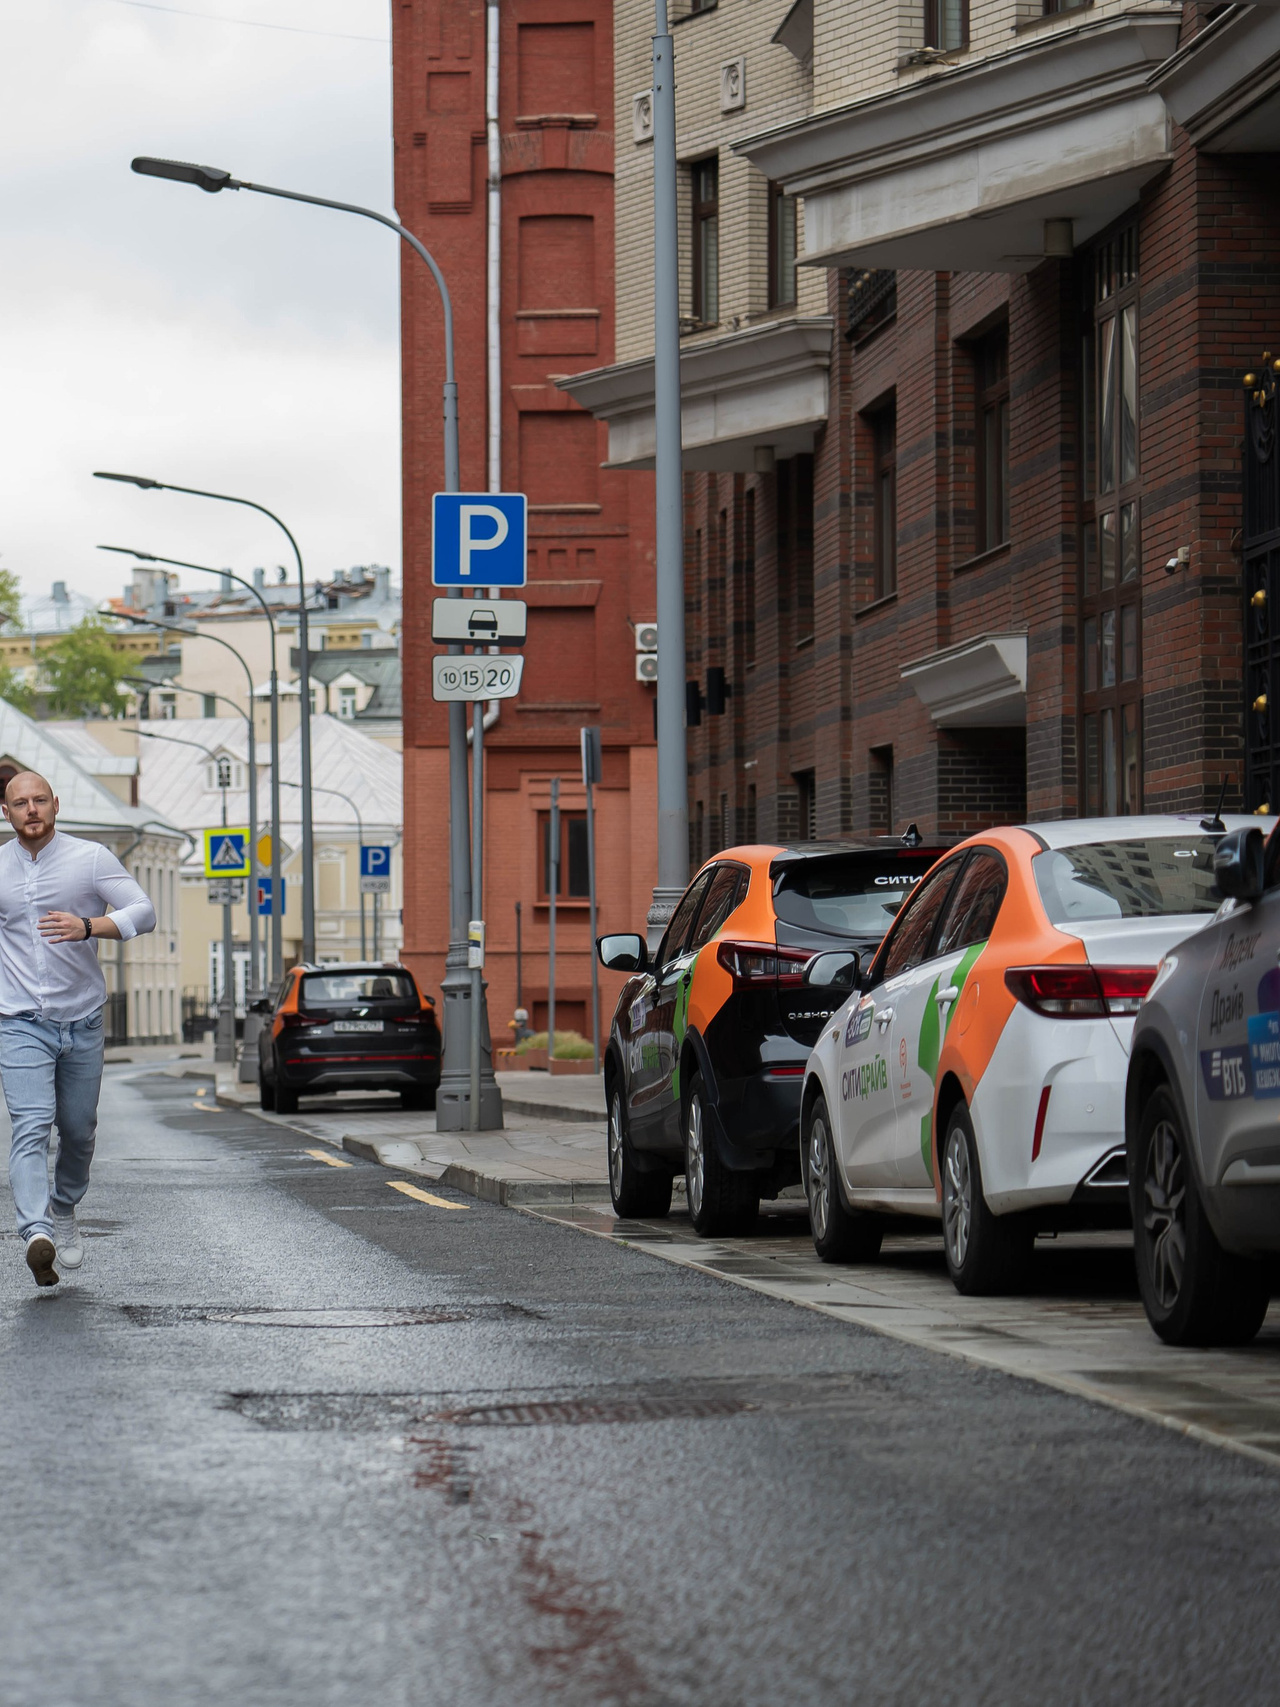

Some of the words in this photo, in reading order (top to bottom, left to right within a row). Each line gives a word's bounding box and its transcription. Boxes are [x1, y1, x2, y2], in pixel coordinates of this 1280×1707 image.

[459, 504, 509, 575] P
[443, 672, 457, 684] 10
[462, 670, 479, 686] 15
[486, 669, 511, 687] 20
[368, 848, 386, 873] P
[1219, 931, 1262, 971] Яндекс
[1210, 983, 1244, 1036] Драйв
[842, 1054, 888, 1101] СИТИДРАЙВ
[1222, 1057, 1246, 1096] ВТБ
